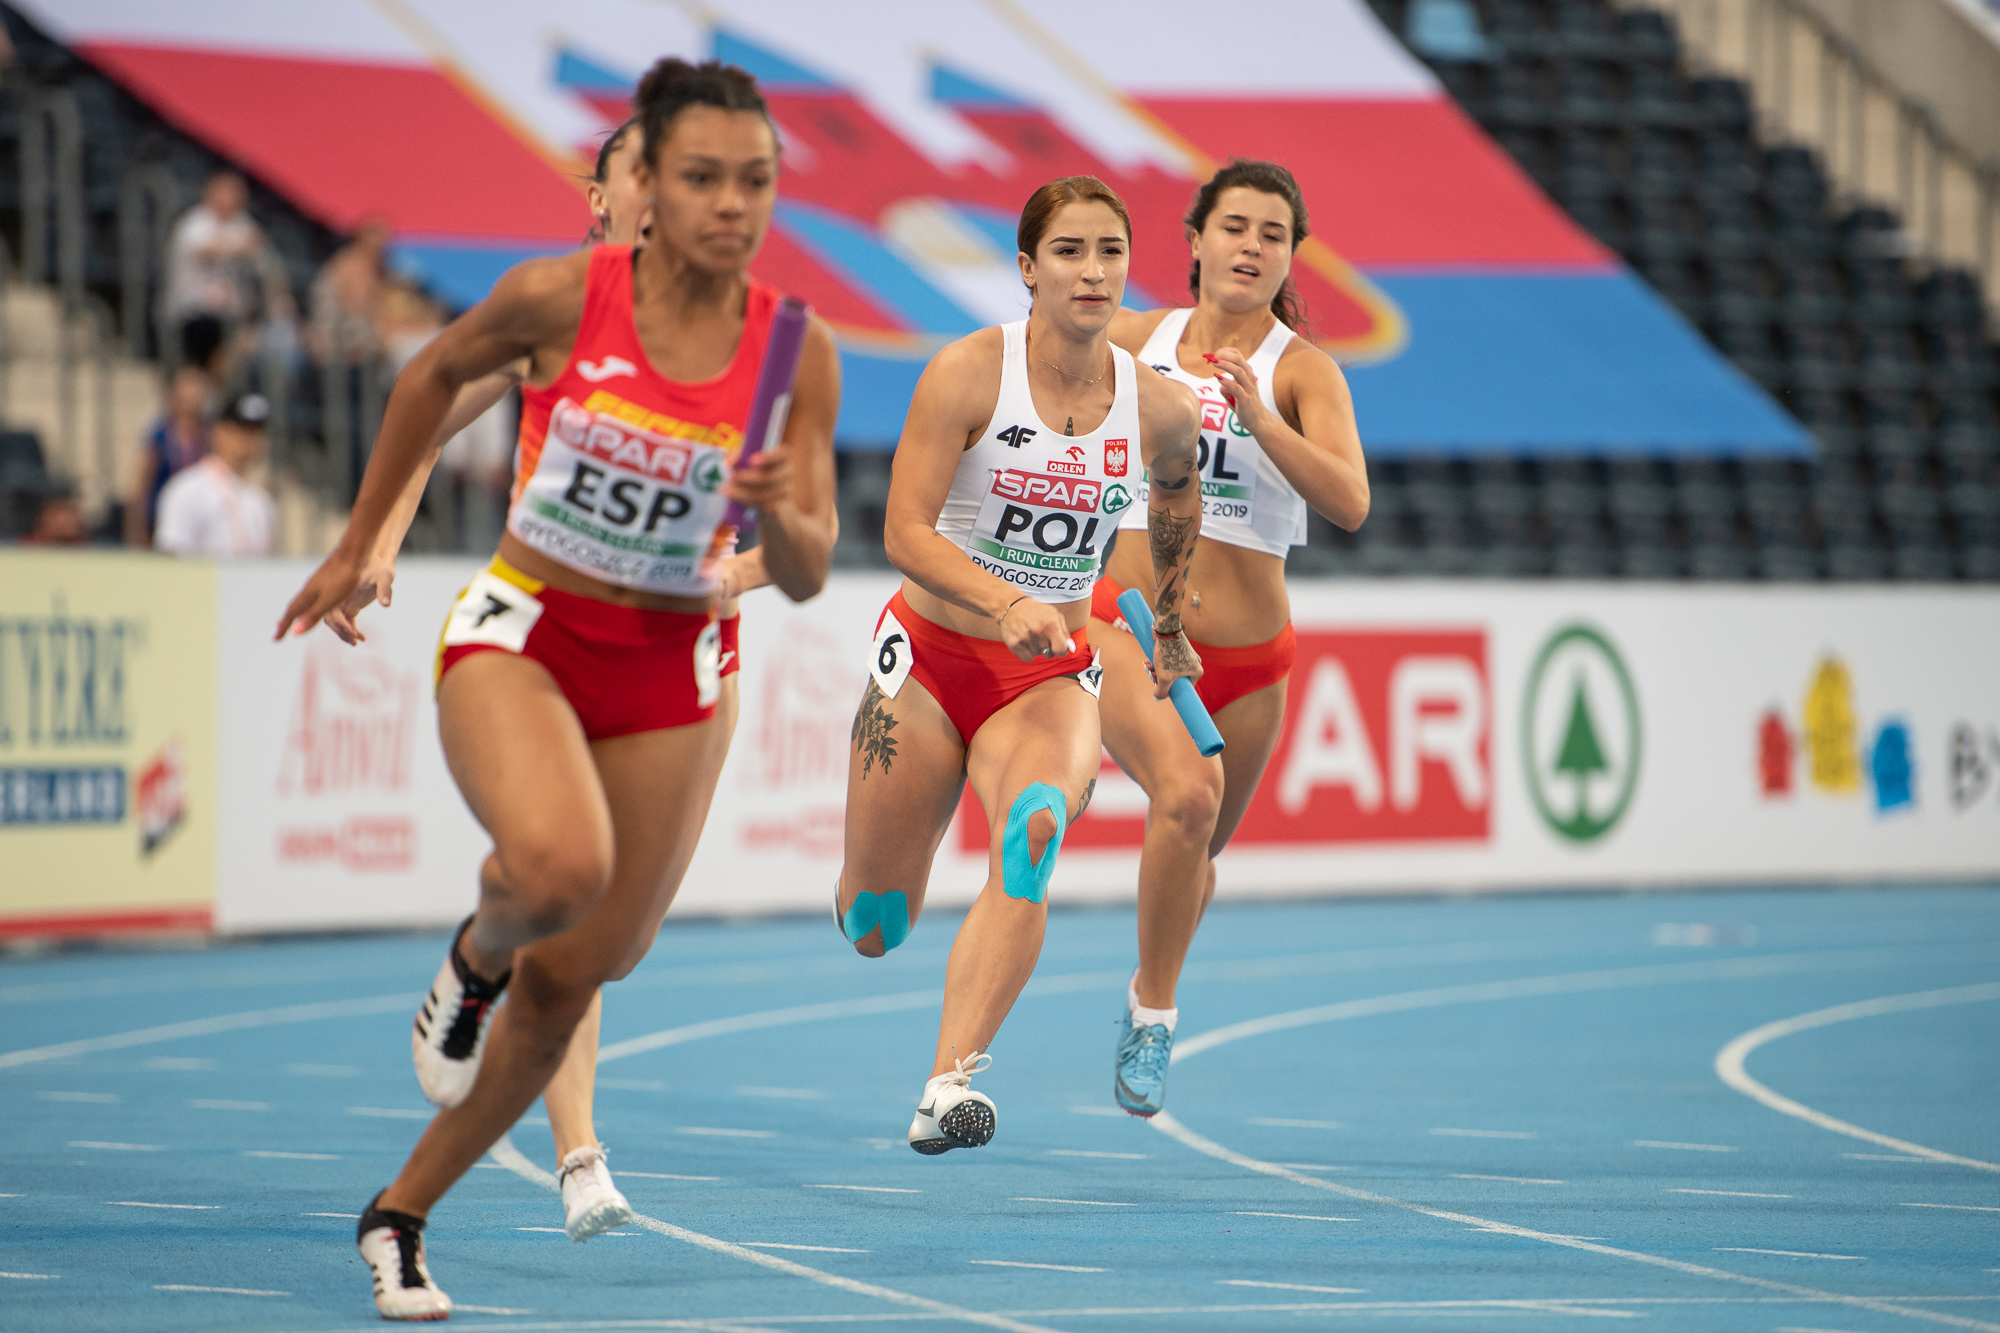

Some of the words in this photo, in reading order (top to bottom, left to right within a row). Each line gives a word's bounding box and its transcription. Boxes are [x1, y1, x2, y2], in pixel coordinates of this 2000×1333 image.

[559, 407, 690, 481] SPAR
[996, 425, 1037, 448] 4F
[1049, 462, 1084, 474] ORLEN
[563, 460, 692, 533] ESP
[996, 474, 1098, 509] SPAR
[1212, 503, 1248, 518] 2019
[994, 503, 1100, 555] POL
[1006, 548, 1037, 566] RUN
[1069, 574, 1094, 591] 209
[879, 634, 905, 675] 6
